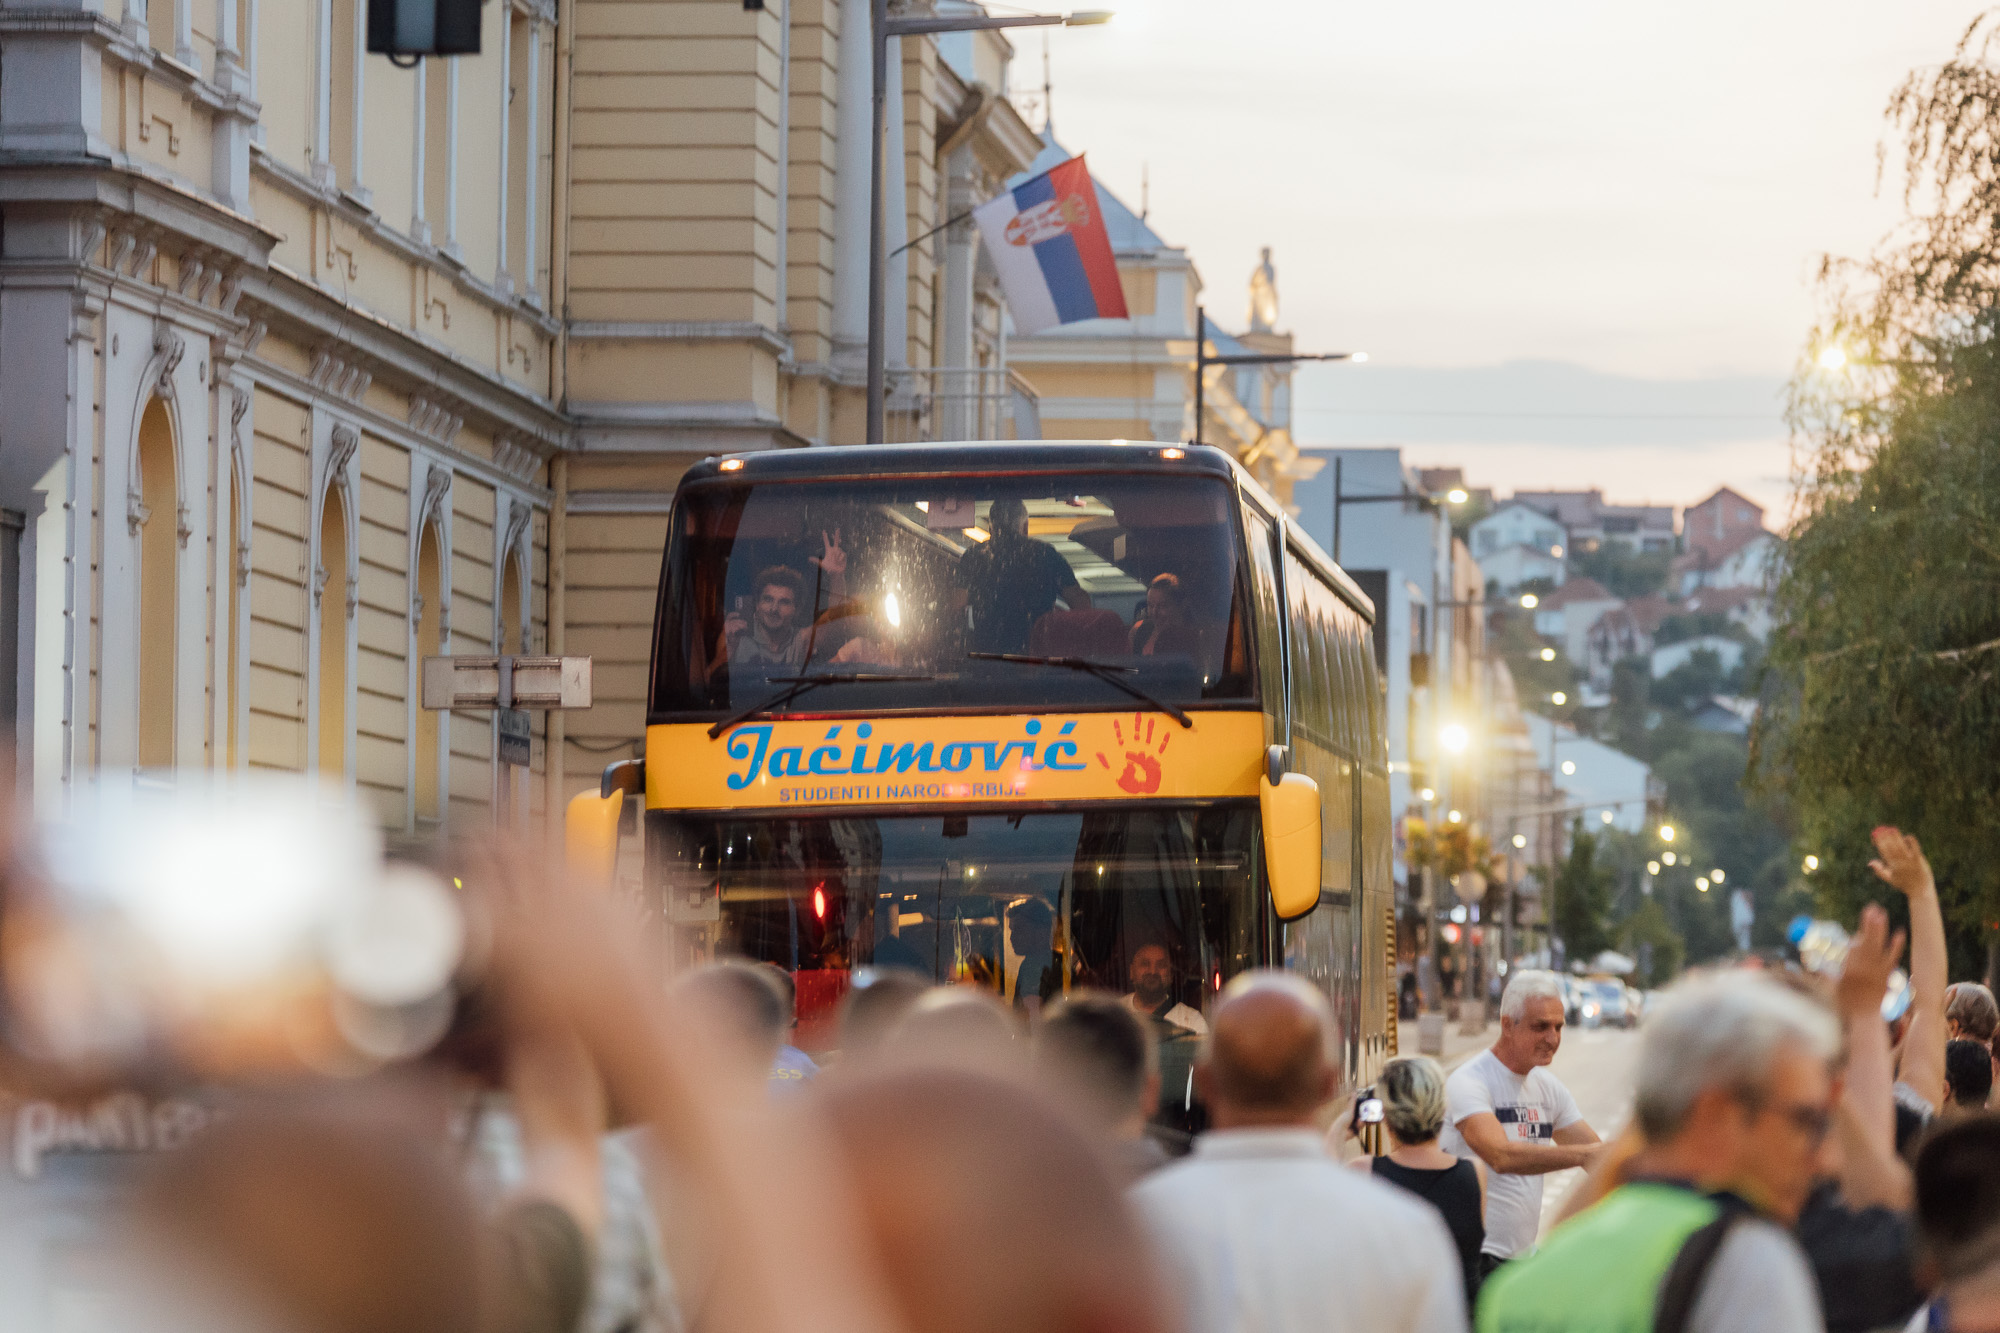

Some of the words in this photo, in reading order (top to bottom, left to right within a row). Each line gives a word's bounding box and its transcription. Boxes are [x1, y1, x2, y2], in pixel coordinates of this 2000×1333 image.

[727, 718, 1087, 790] Jaćimović
[780, 785, 870, 802] STUDENTI
[876, 785, 881, 799] I
